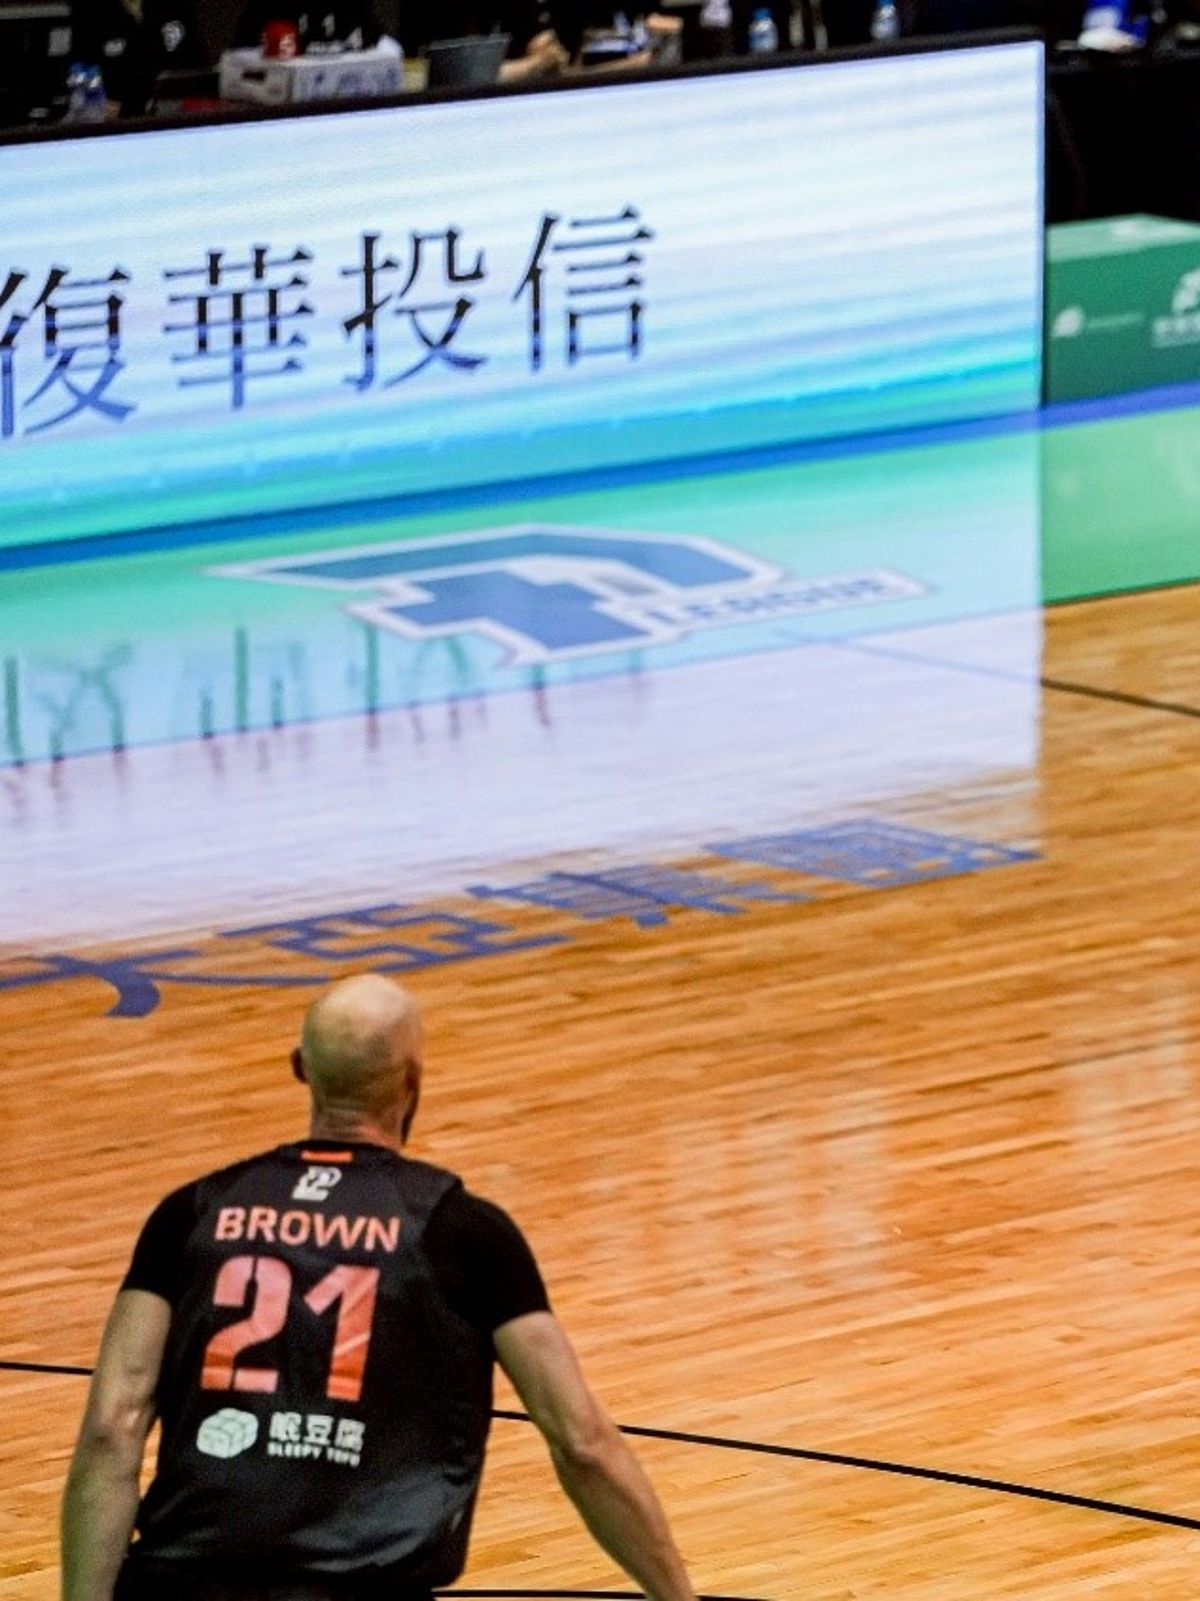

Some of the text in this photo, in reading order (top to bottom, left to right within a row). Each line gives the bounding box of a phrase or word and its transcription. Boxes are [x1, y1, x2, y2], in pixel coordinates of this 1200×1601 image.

[0, 204, 656, 438] 復華投信
[214, 1206, 400, 1252] BROWN
[201, 1255, 381, 1402] 21
